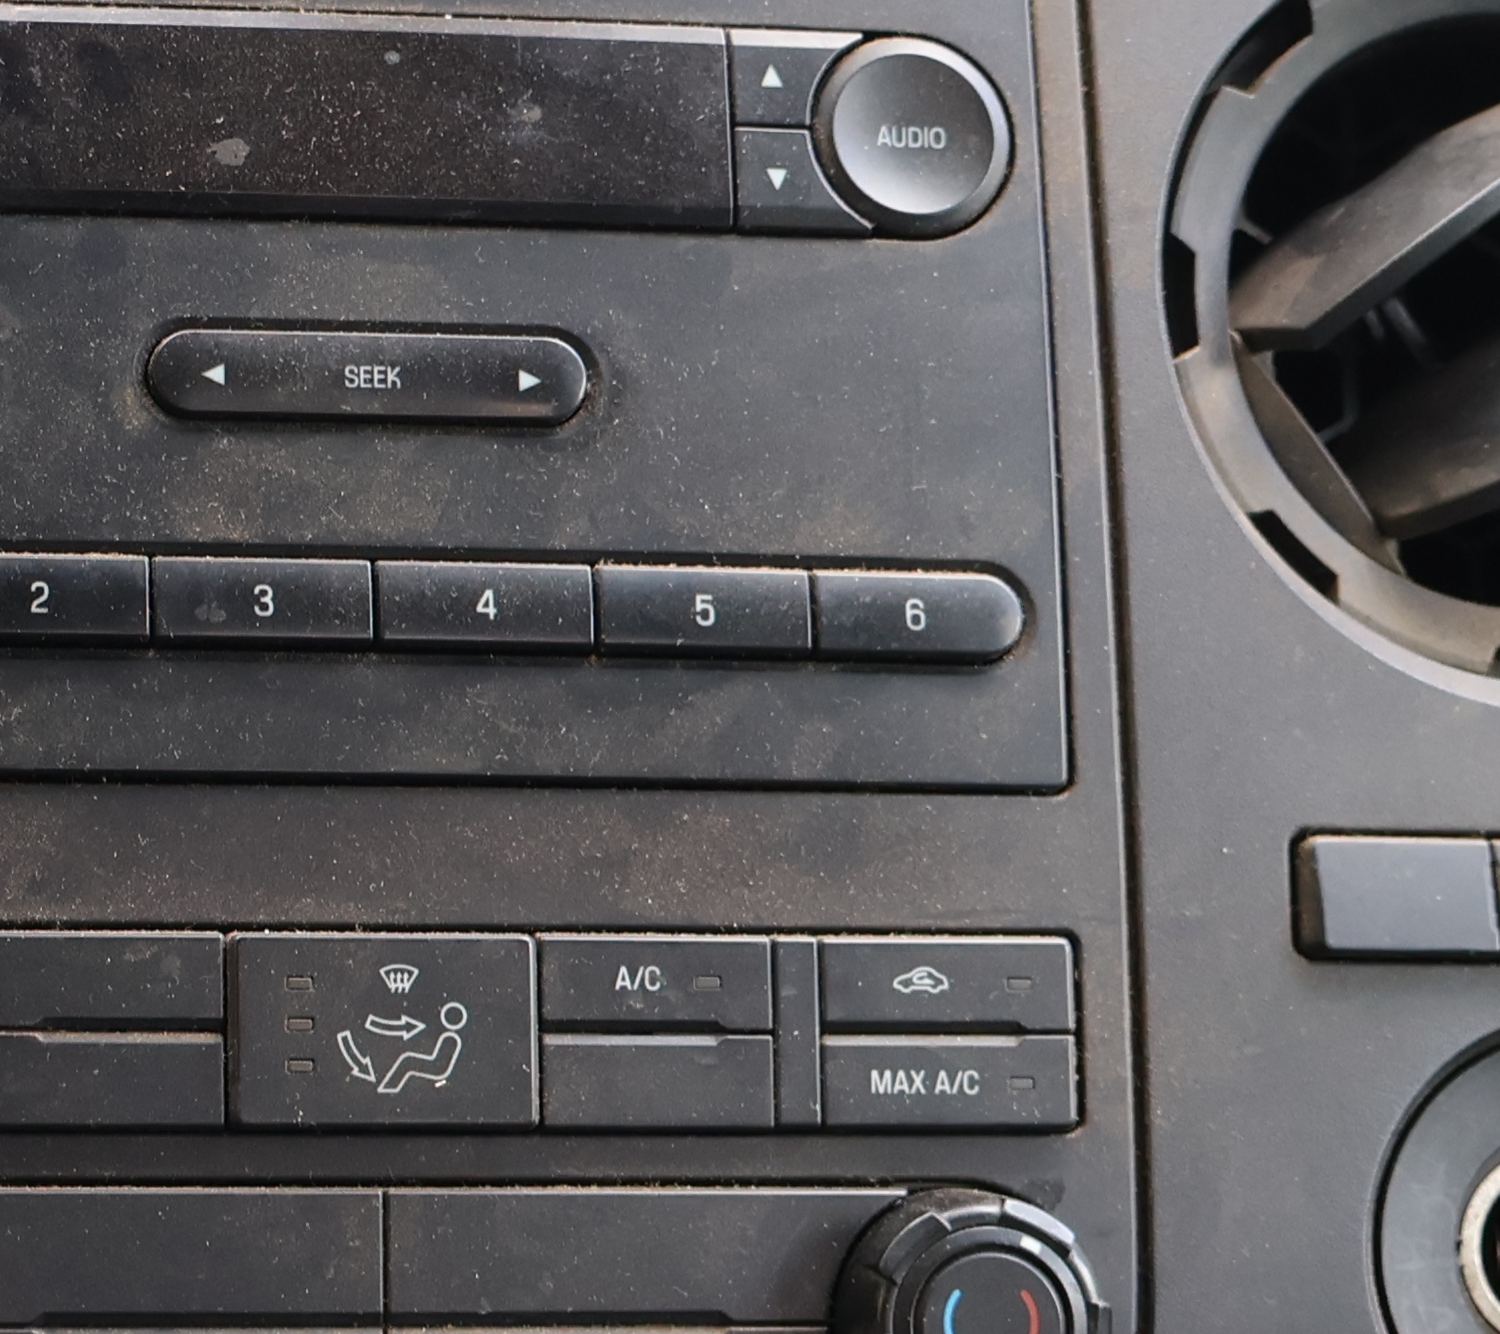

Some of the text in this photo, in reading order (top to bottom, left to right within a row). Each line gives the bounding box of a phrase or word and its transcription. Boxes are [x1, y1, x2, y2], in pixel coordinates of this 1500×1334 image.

[877, 127, 946, 149] AUDIO
[344, 365, 401, 389] SEEK
[30, 582, 50, 613] 2
[253, 585, 274, 617] 3
[476, 589, 497, 620] 4
[694, 595, 716, 626] 5
[905, 599, 926, 630] 6
[614, 966, 662, 993] A/C
[870, 1069, 981, 1096] MAX A/C
